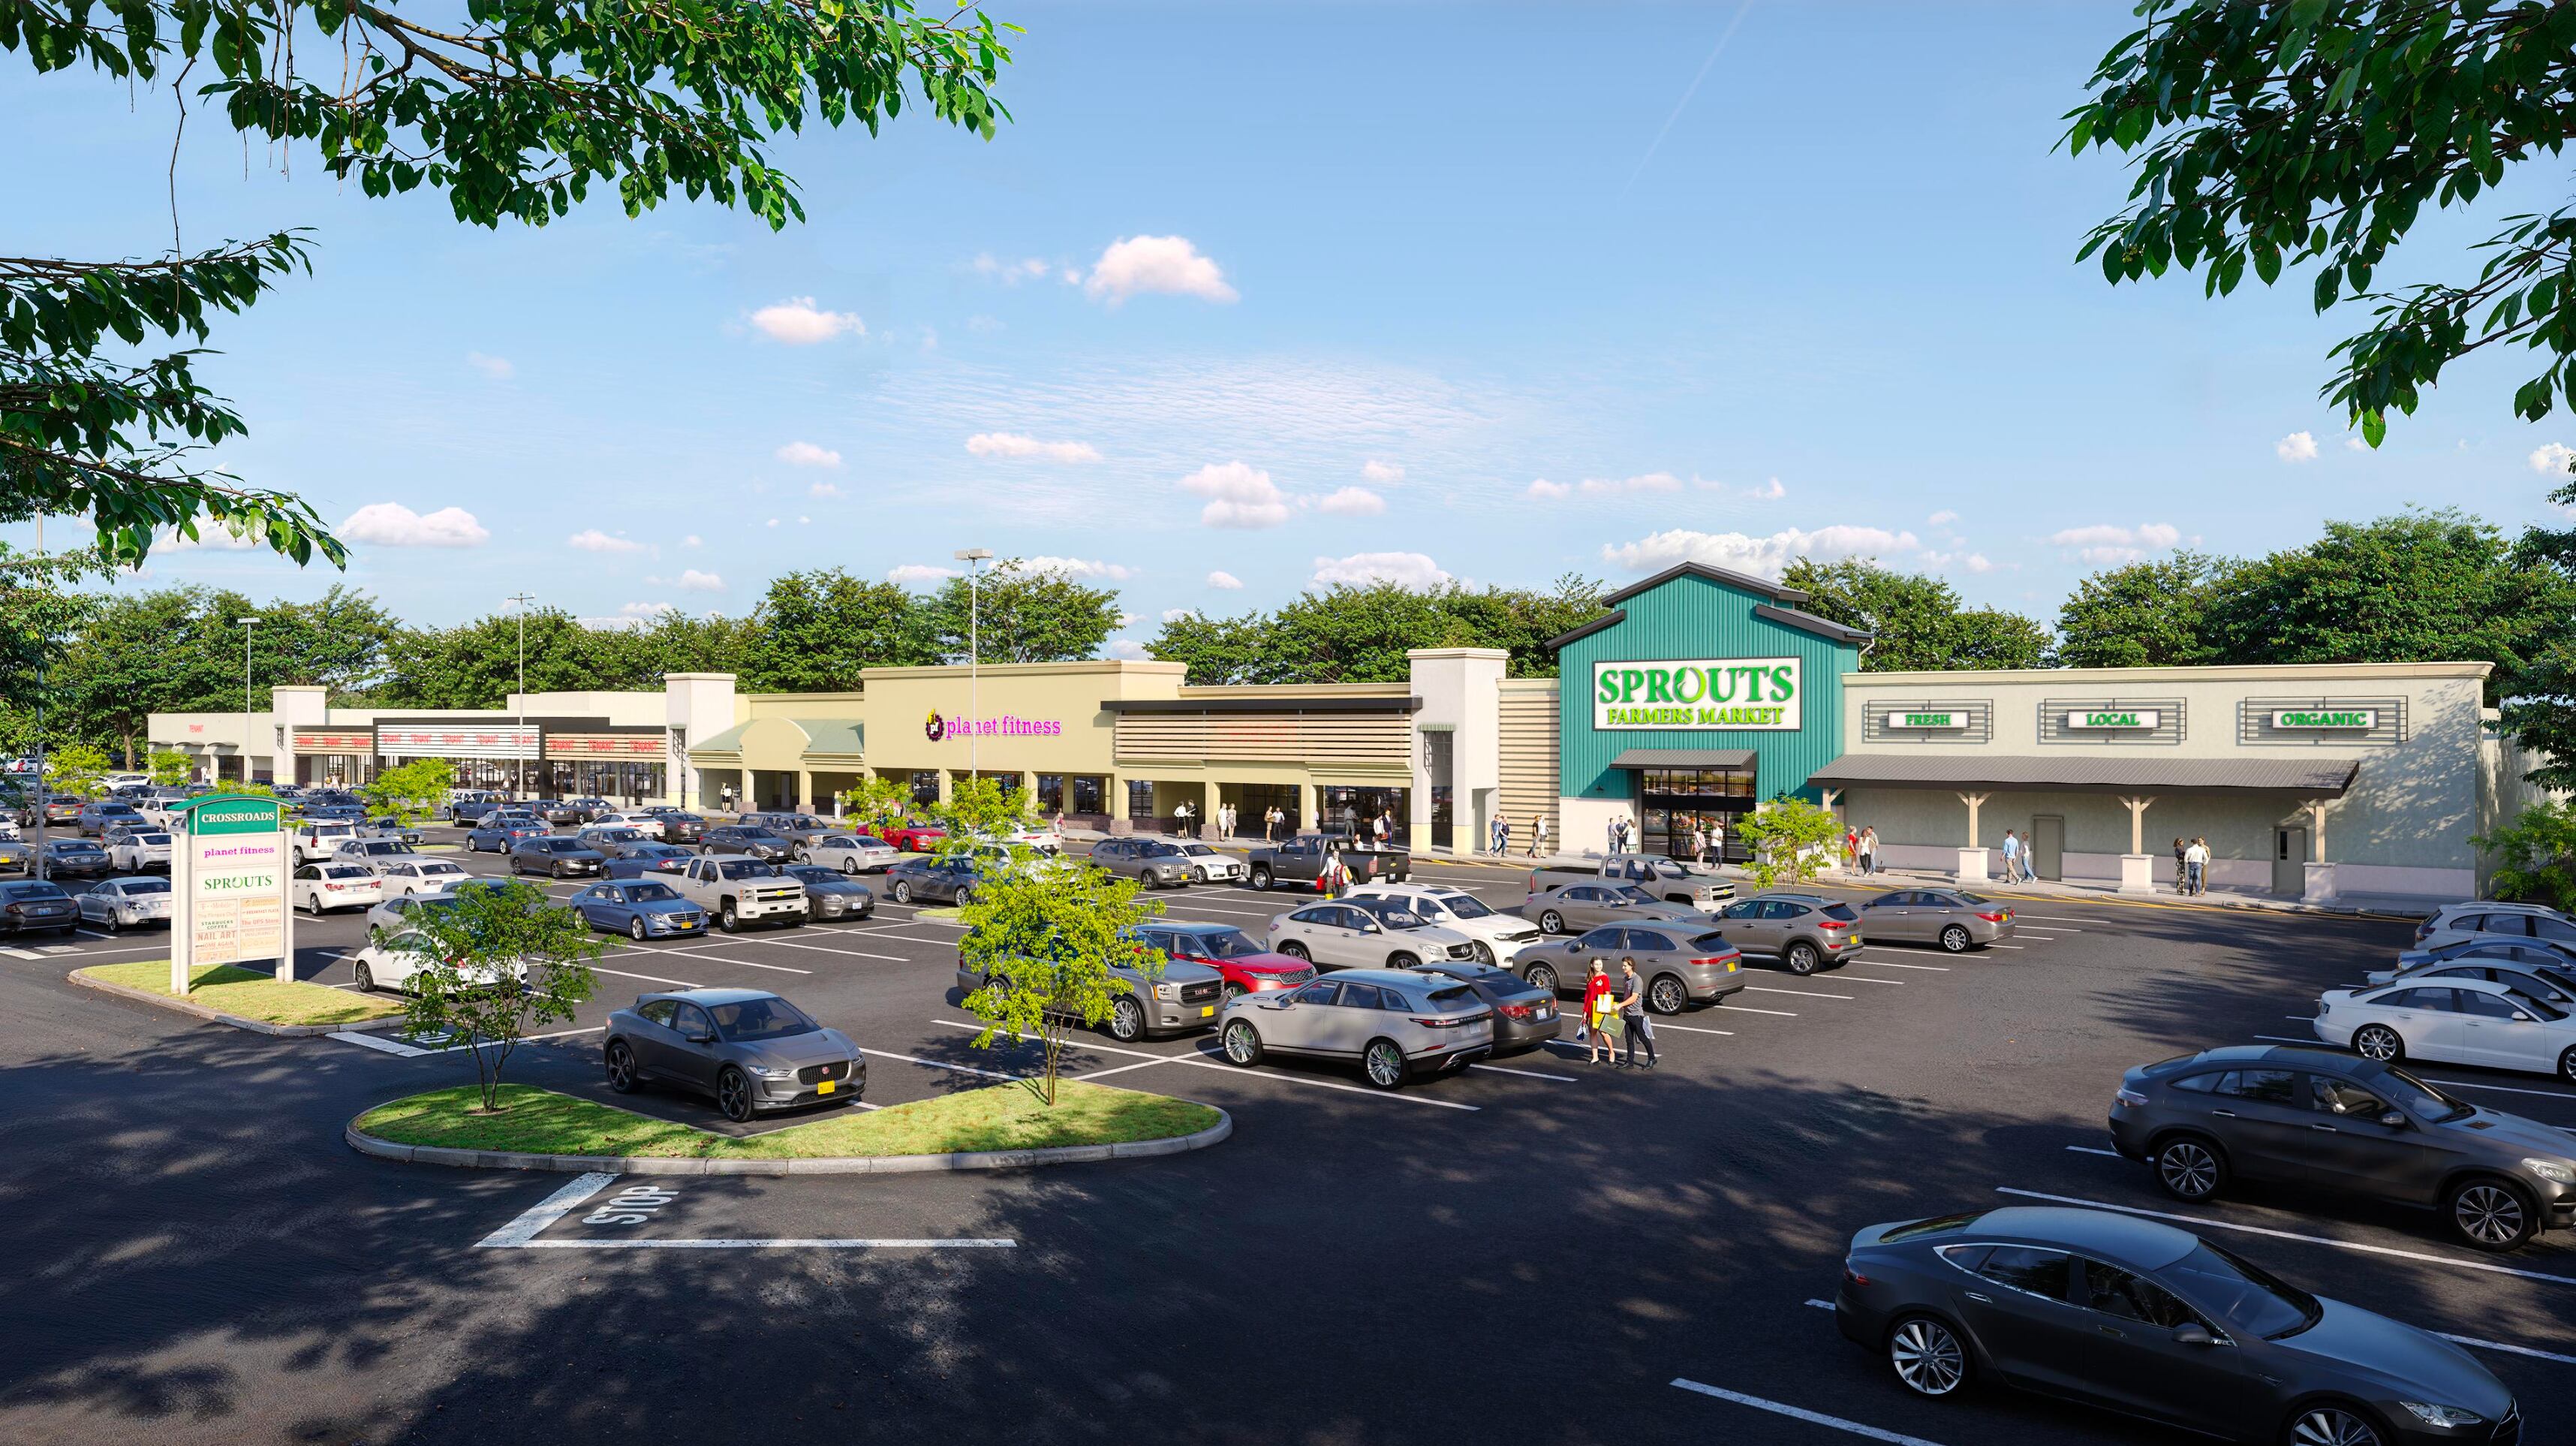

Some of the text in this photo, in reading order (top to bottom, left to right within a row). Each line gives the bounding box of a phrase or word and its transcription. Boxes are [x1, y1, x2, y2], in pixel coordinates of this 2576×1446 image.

[1598, 665, 1795, 703] SPROUTS
[1606, 706, 1785, 725] FARMERS MARKET
[1905, 714, 1951, 726] FRESH
[2086, 713, 2141, 726] LOCAL
[2280, 712, 2367, 726] ORGANIC
[189, 725, 203, 733] TENANT
[946, 715, 1061, 740] planet fitness
[296, 737, 314, 746] TENANT
[322, 737, 342, 746] TENANT
[351, 737, 371, 747] TENANT
[381, 734, 402, 743] TENANT
[411, 734, 432, 743] TENANT
[442, 734, 464, 744] TENANT
[476, 734, 498, 744] TENANT
[511, 734, 535, 745] TEANT
[549, 740, 575, 751] TENANT
[588, 740, 615, 752] TENANT
[629, 740, 658, 752] TENANT
[201, 812, 275, 823] CROSSROADS
[204, 846, 275, 858] planet fitness
[204, 875, 272, 890] SPROUTS
[197, 930, 236, 941] NAIL ART
[582, 1185, 679, 1225] STOP
